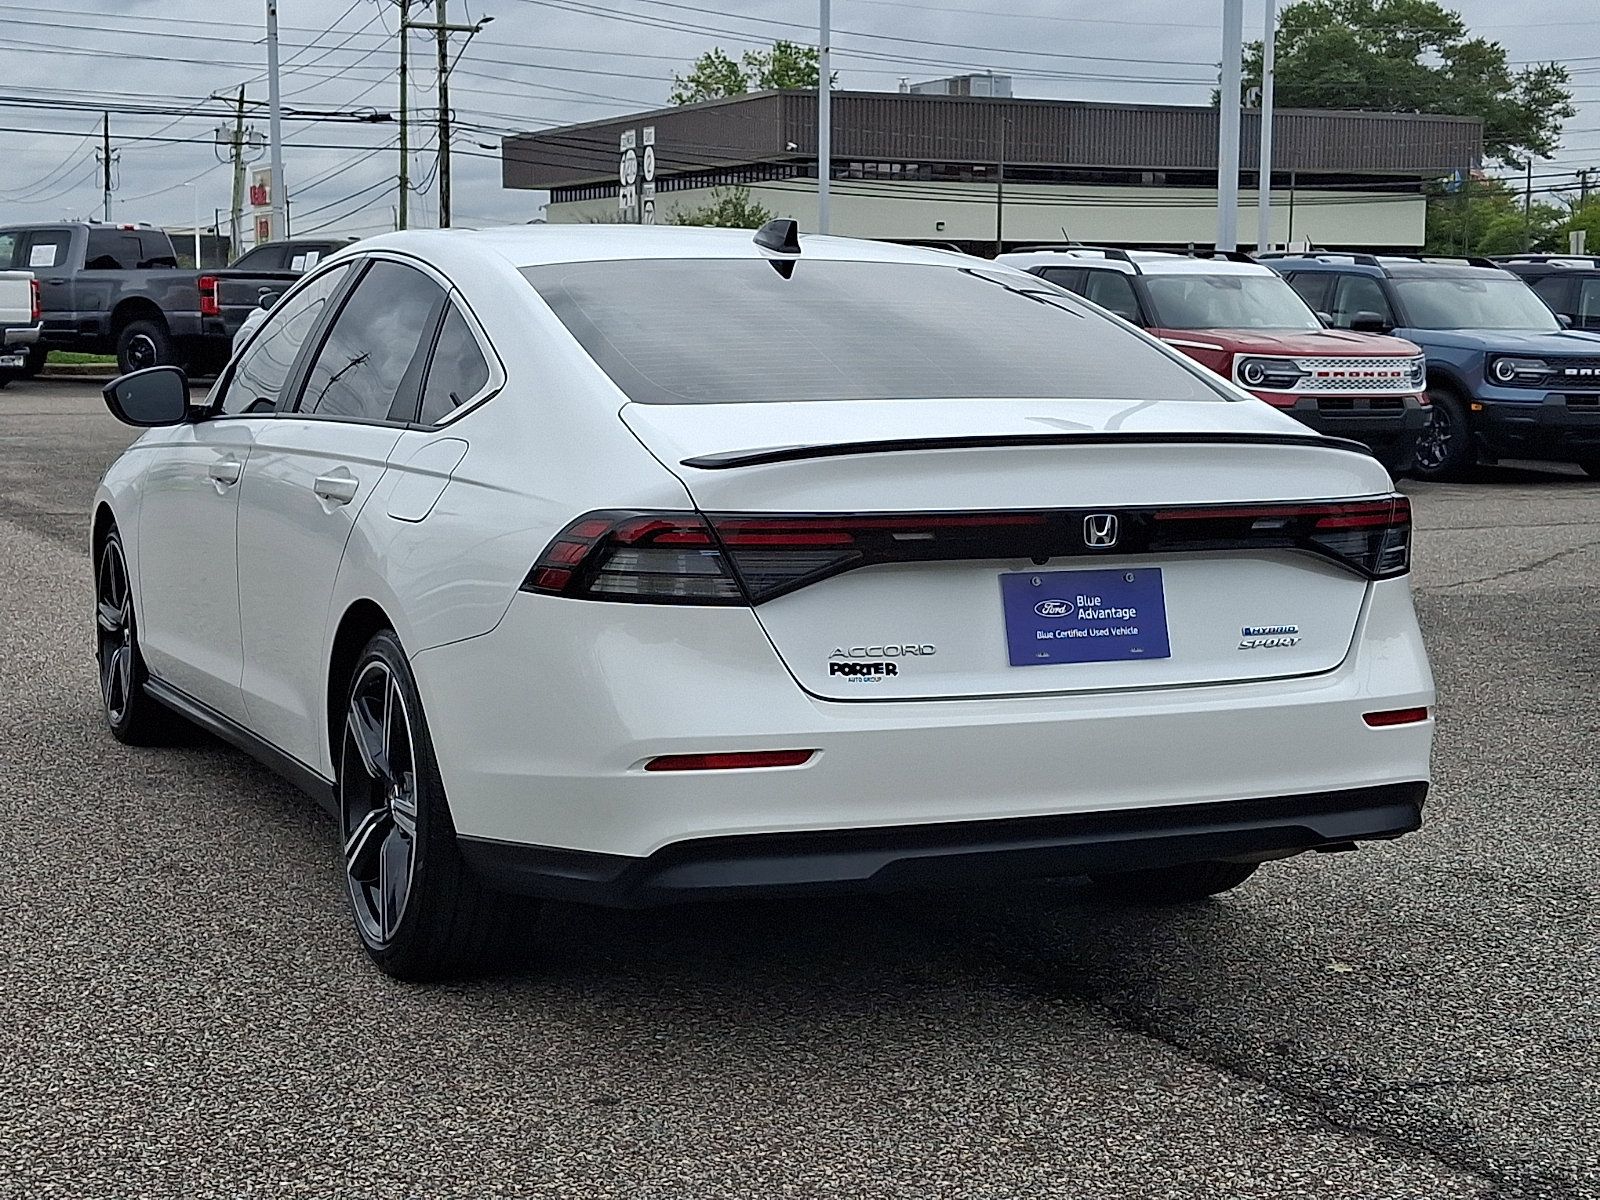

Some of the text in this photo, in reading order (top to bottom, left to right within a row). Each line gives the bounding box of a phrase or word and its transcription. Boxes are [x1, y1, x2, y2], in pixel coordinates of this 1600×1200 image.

[1076, 595, 1101, 607] Blue
[1042, 602, 1067, 615] Ford
[1078, 606, 1137, 620] Advantage
[1036, 626, 1139, 639] Blue Certified Used Vehicle
[1252, 626, 1297, 635] HYBRID
[1237, 638, 1302, 650] SPORT
[828, 644, 937, 659] ACCORD
[828, 661, 899, 677] PORTER
